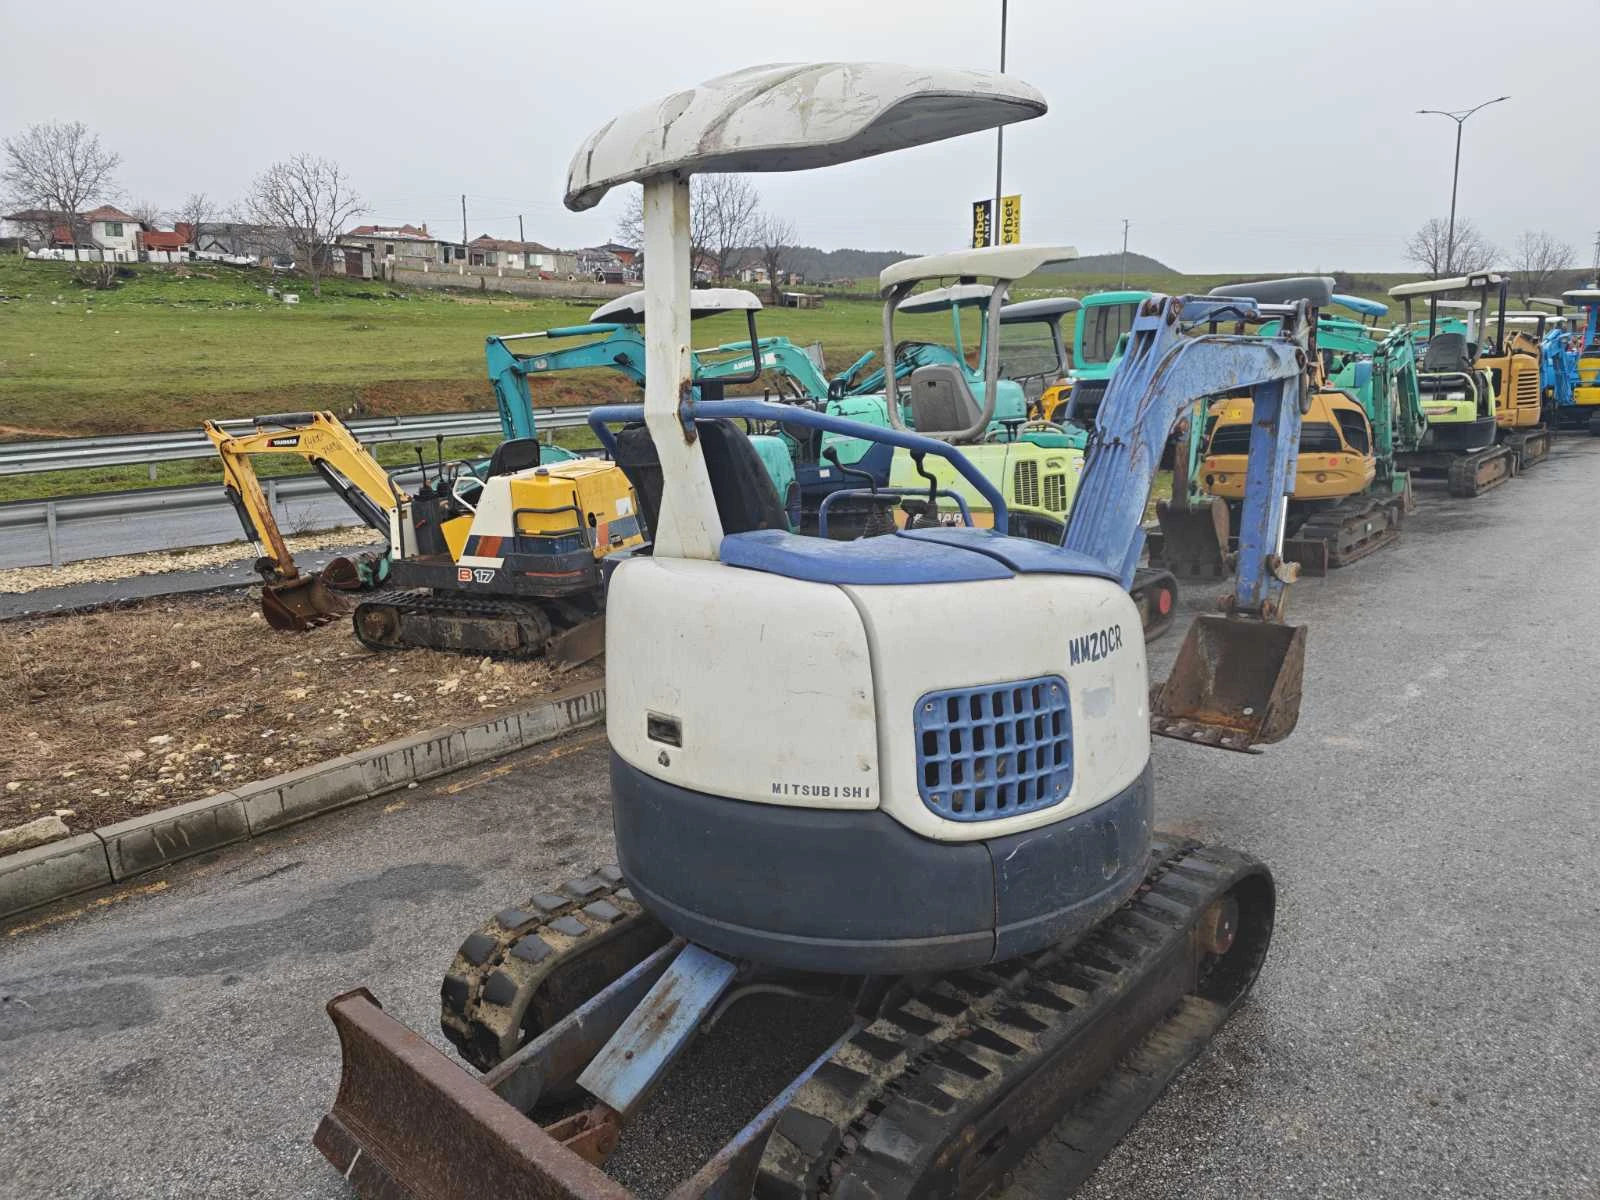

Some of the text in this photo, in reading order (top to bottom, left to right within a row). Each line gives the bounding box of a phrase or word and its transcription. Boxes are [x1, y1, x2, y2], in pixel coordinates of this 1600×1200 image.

[975, 204, 985, 248] efbet
[1004, 200, 1014, 244] efbet
[771, 782, 871, 799] MITSUBISHI
